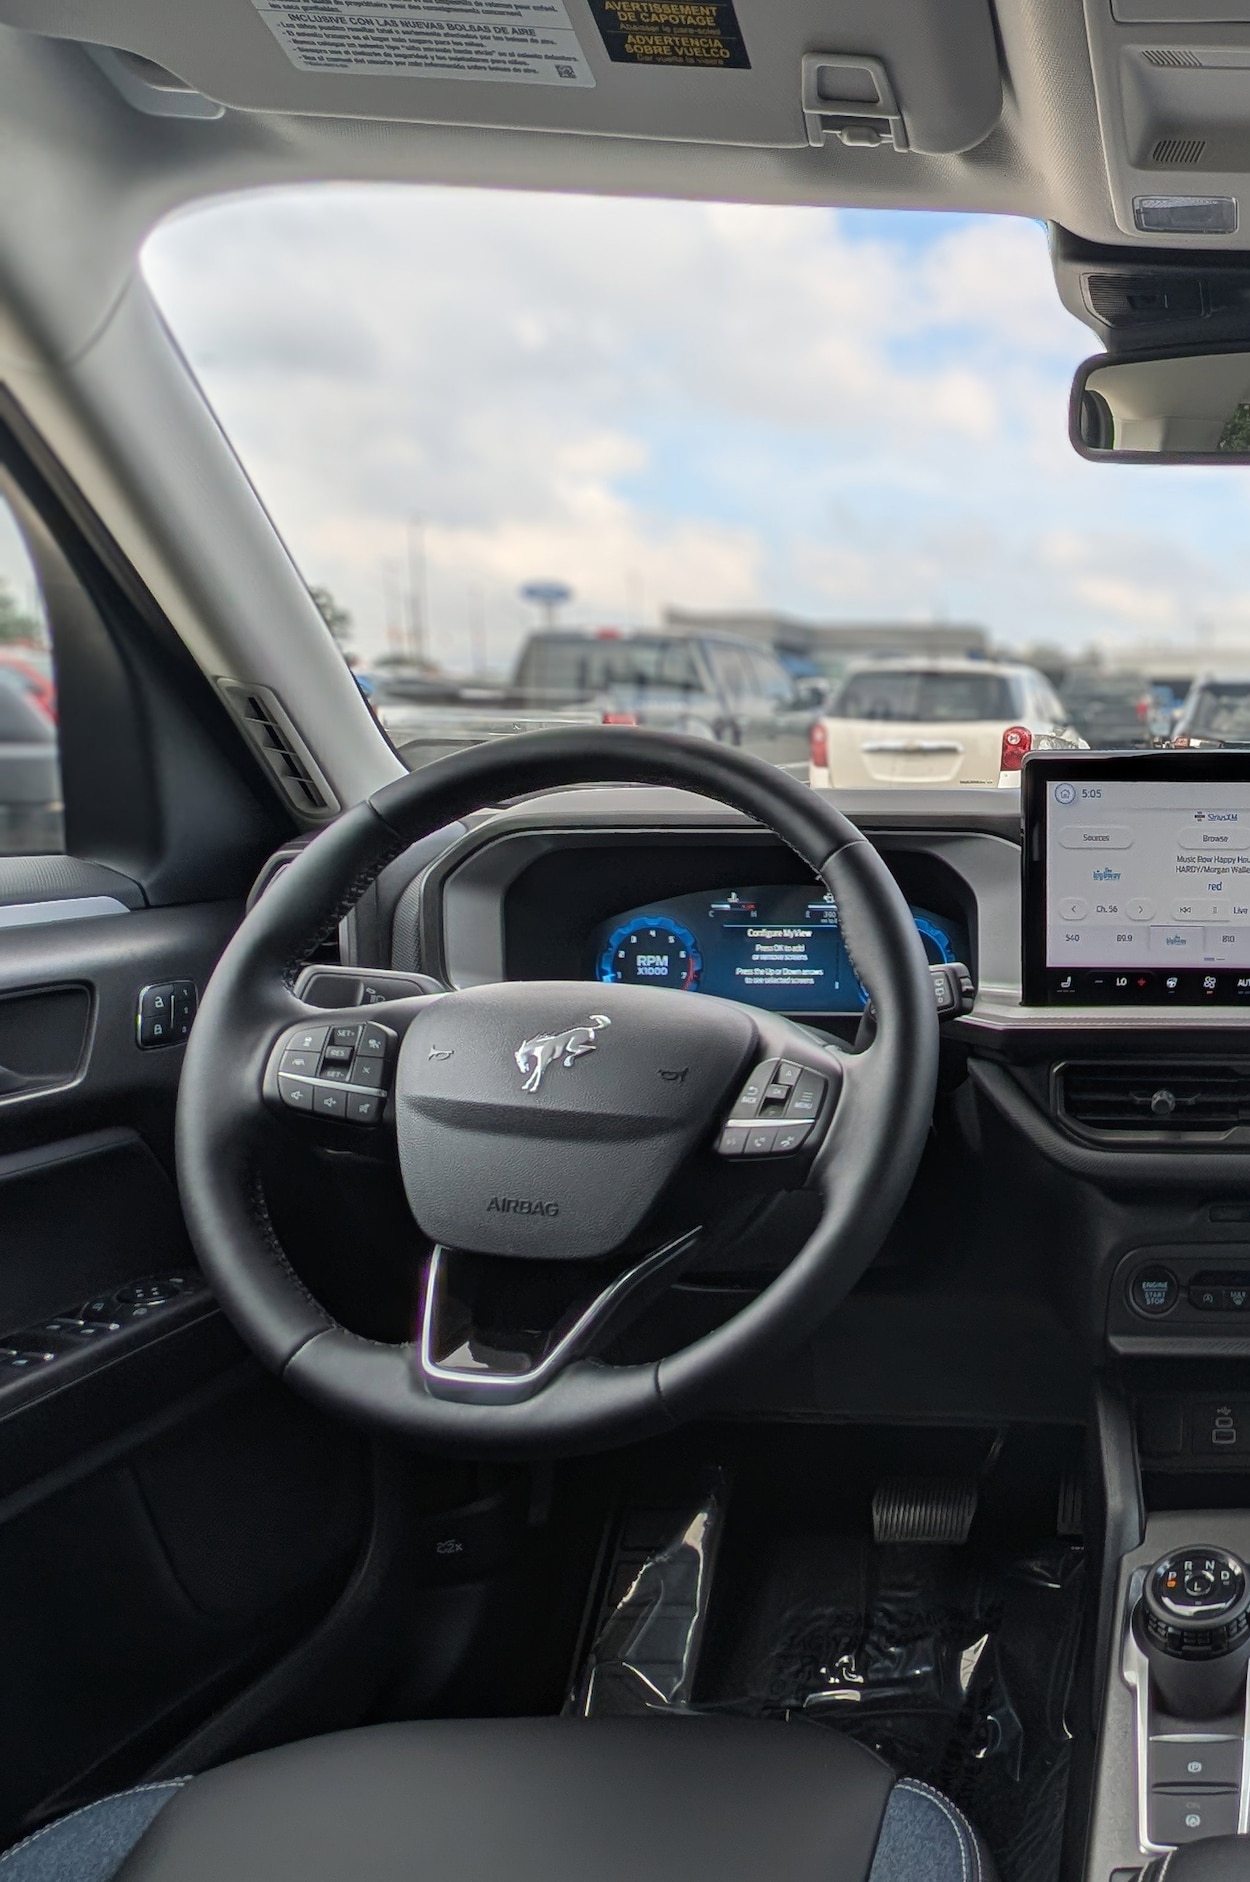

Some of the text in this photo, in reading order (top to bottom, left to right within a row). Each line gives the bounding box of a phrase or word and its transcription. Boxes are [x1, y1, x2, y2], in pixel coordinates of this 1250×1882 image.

[604, 1, 718, 16] AVERTISSEMENT
[617, 11, 715, 26] DE CAPOTAGE
[288, 13, 347, 24] INCLUSIVE
[350, 17, 374, 26] CON
[376, 19, 399, 27] LAS
[400, 20, 445, 30] NUEVAS
[447, 23, 491, 33] BOLSAS
[493, 26, 509, 34] DE
[511, 27, 537, 36] AIRE
[627, 34, 723, 48] ADVERTENCIA
[624, 44, 730, 58] SOBRE VUELCO
[1082, 789, 1101, 798] 5:05
[1083, 834, 1110, 842] Sources
[1214, 856, 1236, 864] Happy
[1208, 881, 1223, 891] red
[1108, 905, 1118, 913] 56
[1233, 906, 1248, 914] Live
[747, 929, 782, 939] Configure
[618, 950, 625, 958] 2
[636, 955, 669, 967] RPM
[636, 967, 668, 976] X1000
[1116, 978, 1127, 986] LO
[486, 1197, 559, 1216] AIRBAG
[1184, 1561, 1192, 1571] R
[1205, 1560, 1215, 1570] N
[1168, 1571, 1177, 1580] P
[1221, 1571, 1230, 1580] D
[1194, 1581, 1201, 1591] L
